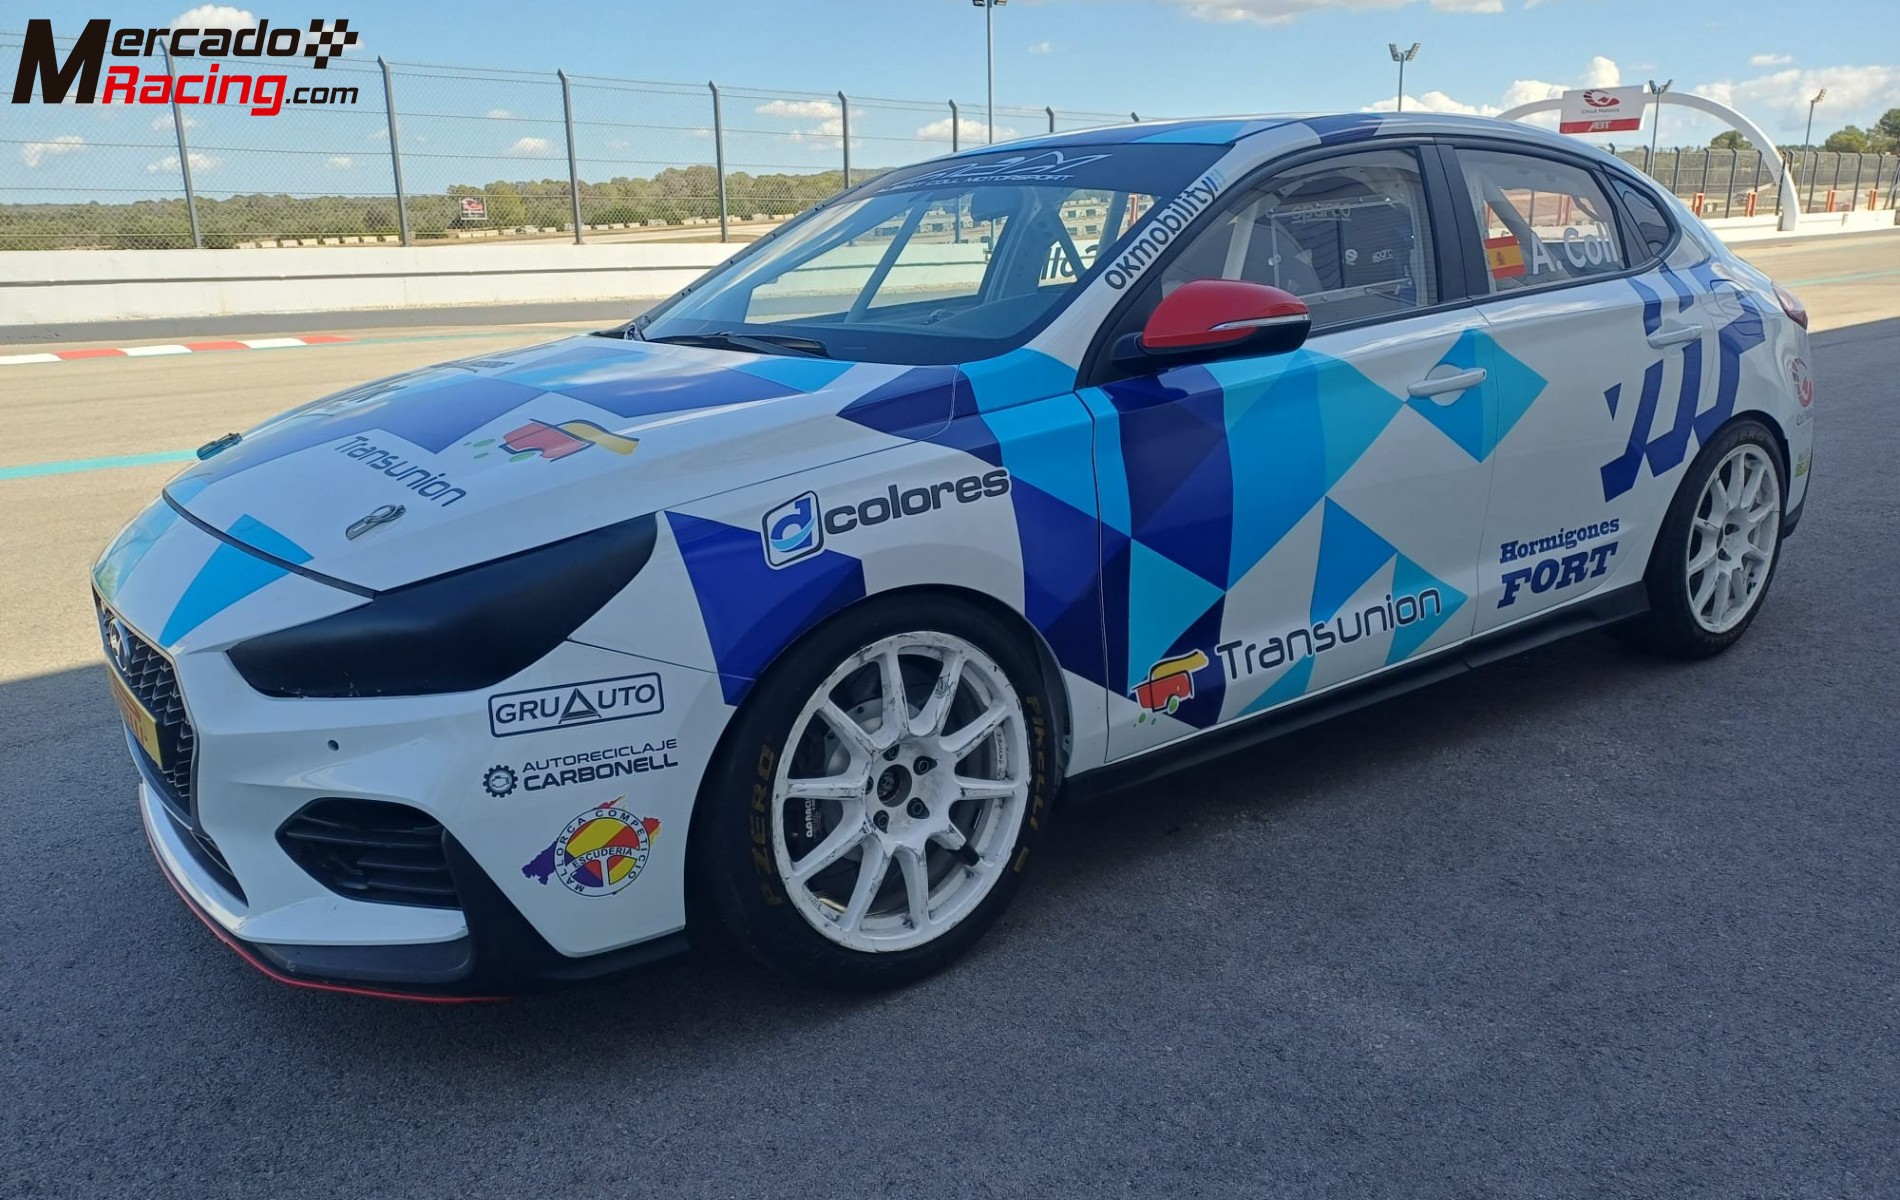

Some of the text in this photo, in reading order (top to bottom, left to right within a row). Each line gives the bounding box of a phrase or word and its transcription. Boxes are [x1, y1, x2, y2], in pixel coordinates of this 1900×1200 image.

[965, 174, 1074, 183] MOTORSPORT
[1563, 222, 1619, 269] Coll
[334, 435, 467, 508] Transunion
[1500, 518, 1620, 564] Hormigones
[1497, 541, 1619, 609] FORT
[1216, 589, 1442, 680] Transunion
[522, 738, 678, 773] AUTORECICLAJE
[523, 753, 679, 792] CARBONELL
[1026, 695, 1047, 832] PIRELLI
[750, 743, 775, 875] ZERO
[555, 817, 586, 893] MALLORCA
[571, 847, 633, 869] ESCUDERIA
